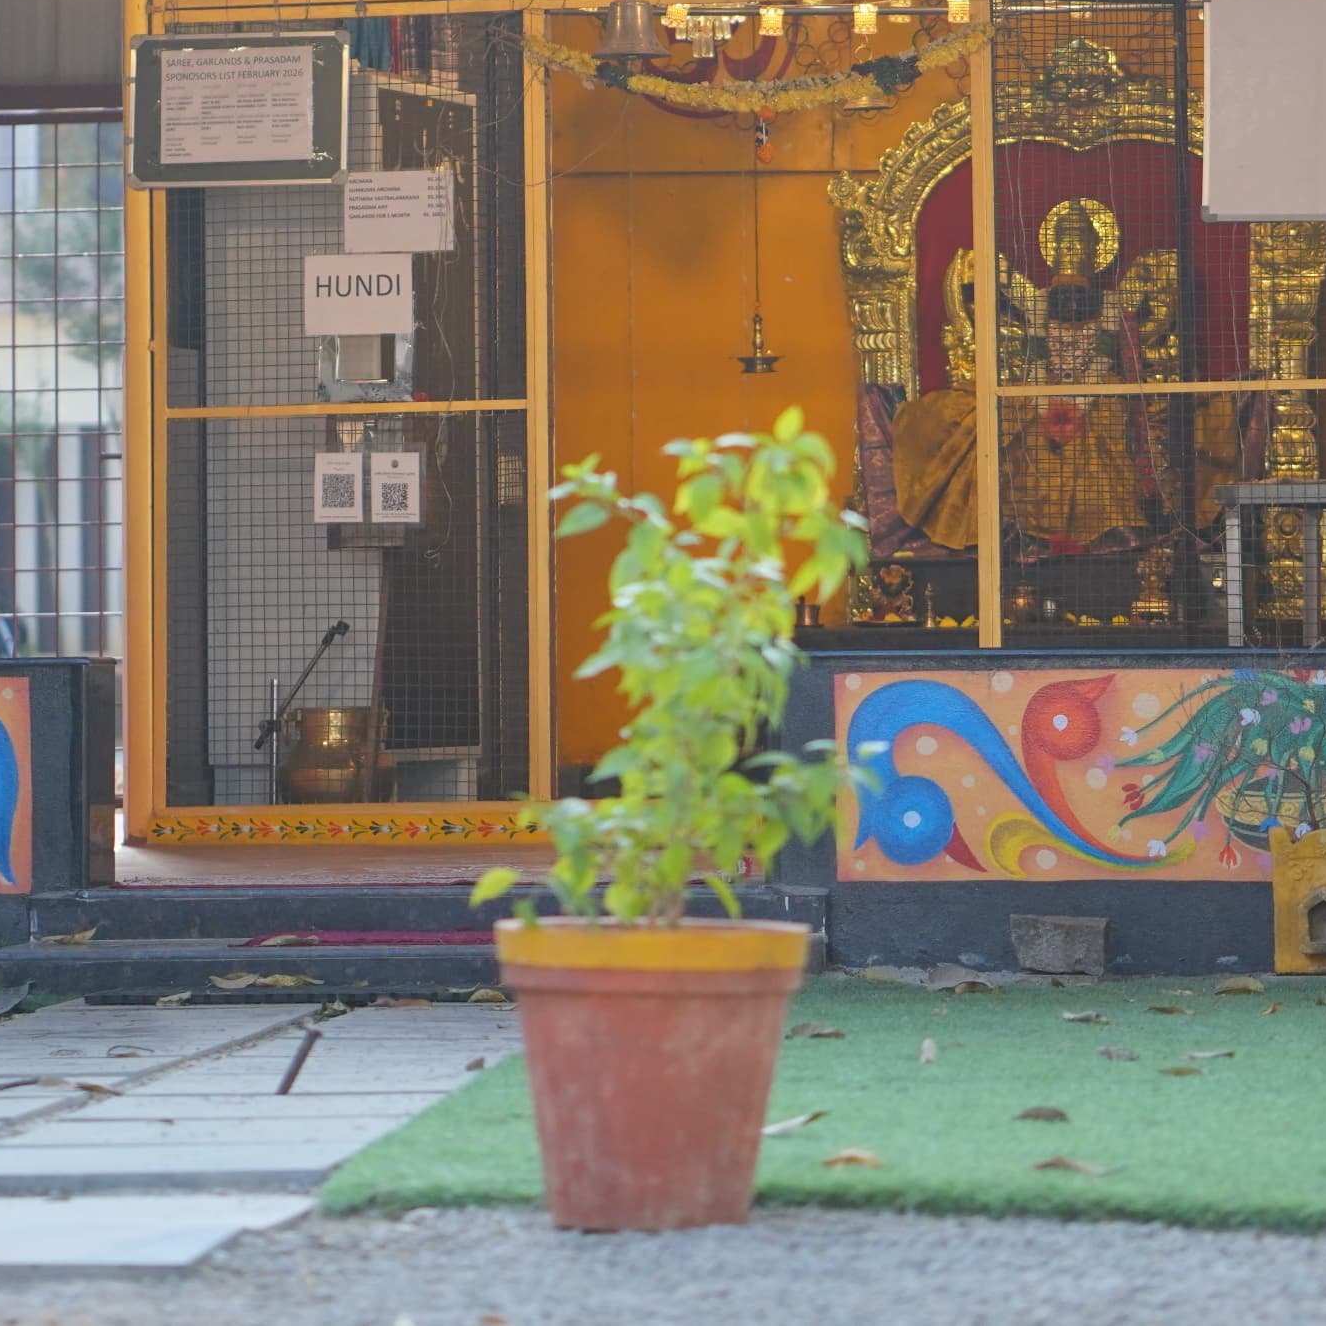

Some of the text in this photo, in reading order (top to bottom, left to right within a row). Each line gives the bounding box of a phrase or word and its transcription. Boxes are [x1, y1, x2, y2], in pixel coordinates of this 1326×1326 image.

[166, 54, 301, 68] SAREE, GARLANDS & PRASADAM
[219, 70, 236, 80] LIST
[237, 68, 280, 79] FEBRUARY
[283, 67, 303, 77] 2026
[316, 273, 401, 298] HUNDI
